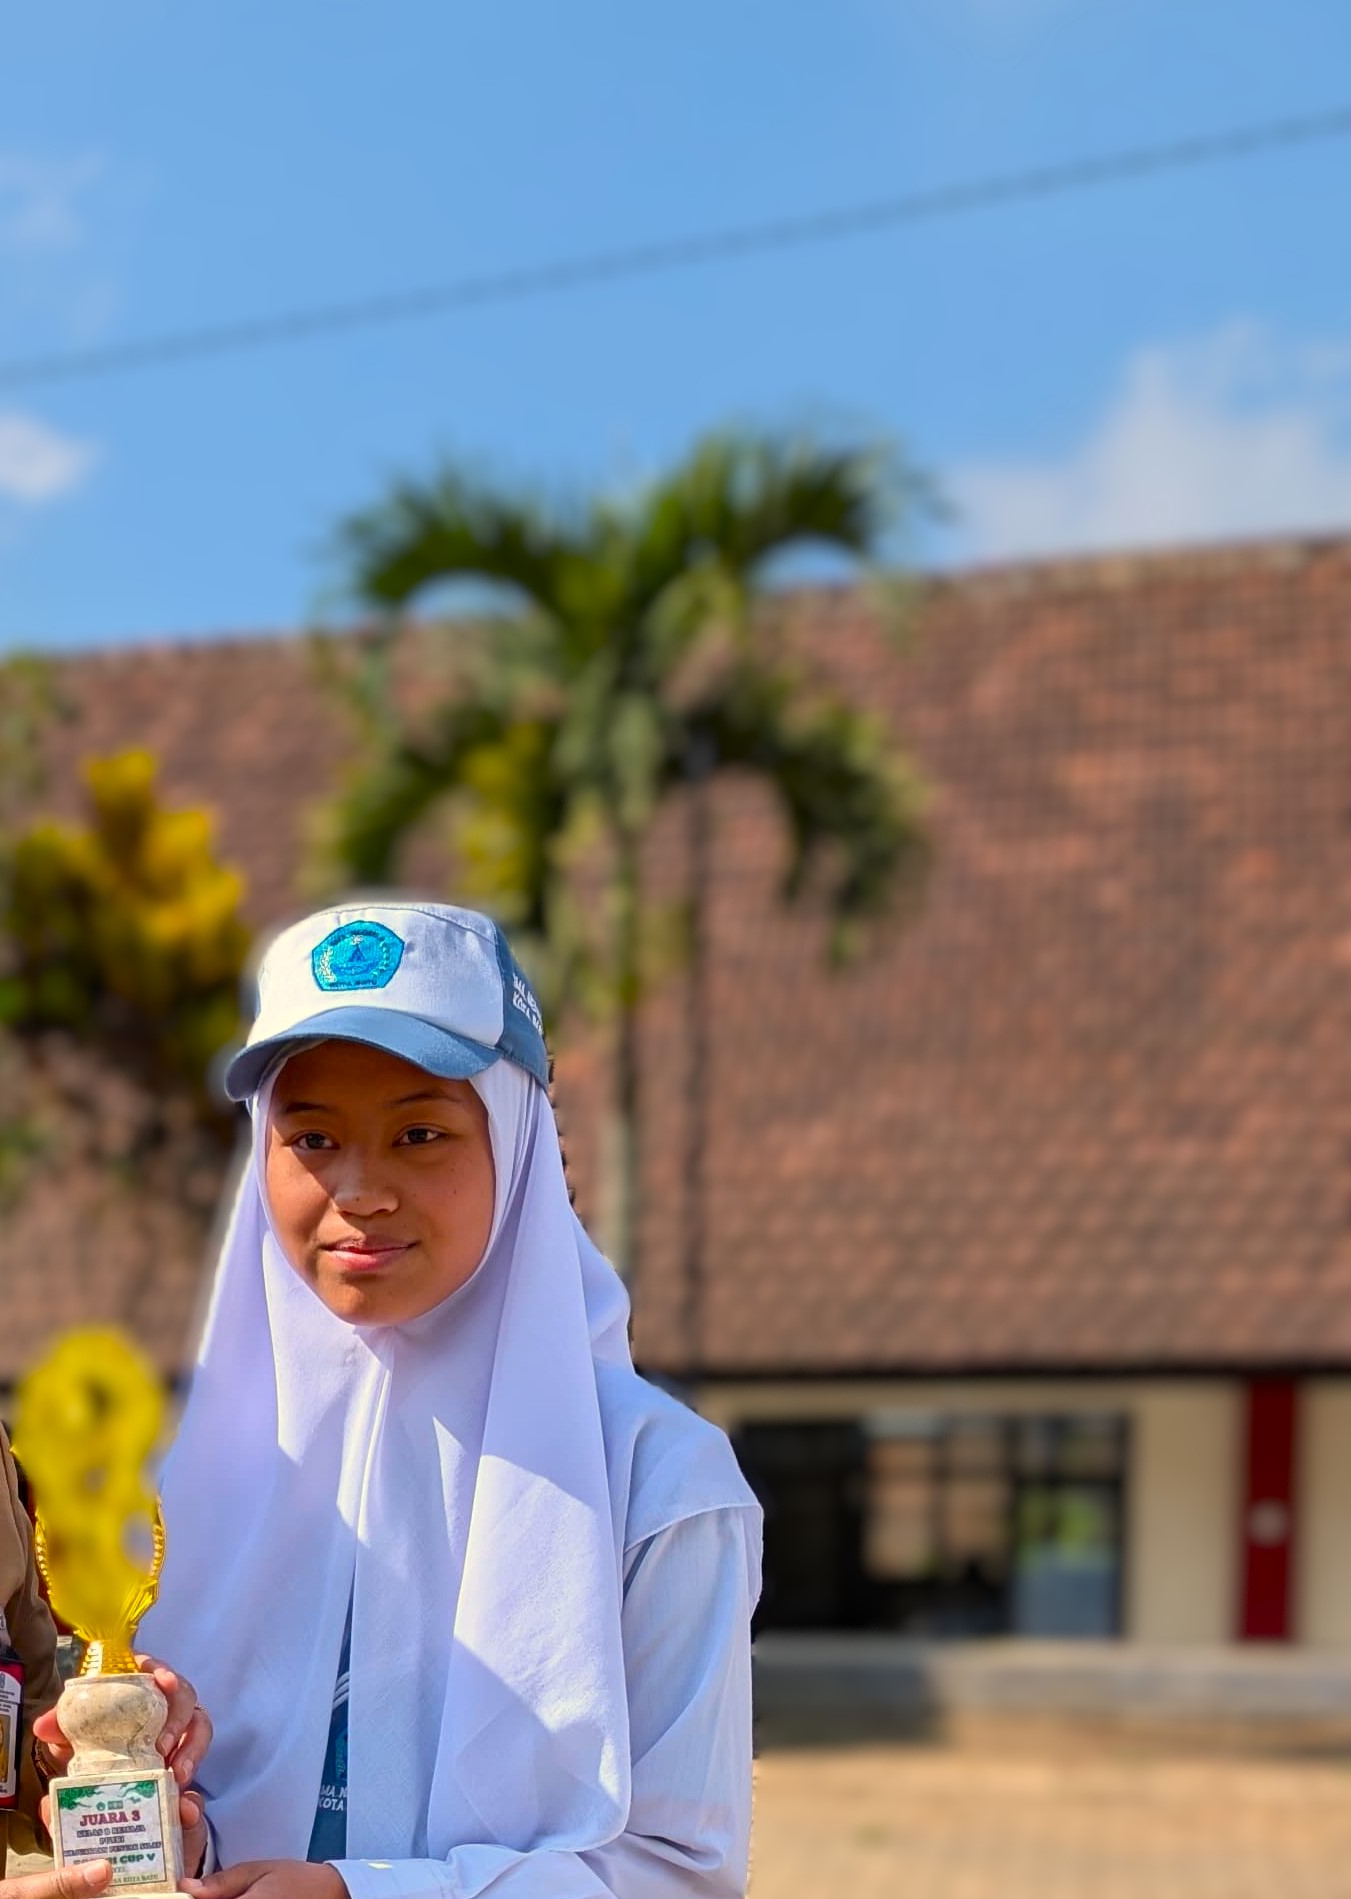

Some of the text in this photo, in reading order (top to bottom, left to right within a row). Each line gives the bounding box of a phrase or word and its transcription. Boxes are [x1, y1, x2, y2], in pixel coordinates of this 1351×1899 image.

[79, 1810, 141, 1827] JUARA 3
[119, 1854, 145, 1865] CUP
[146, 1853, 156, 1862] V
